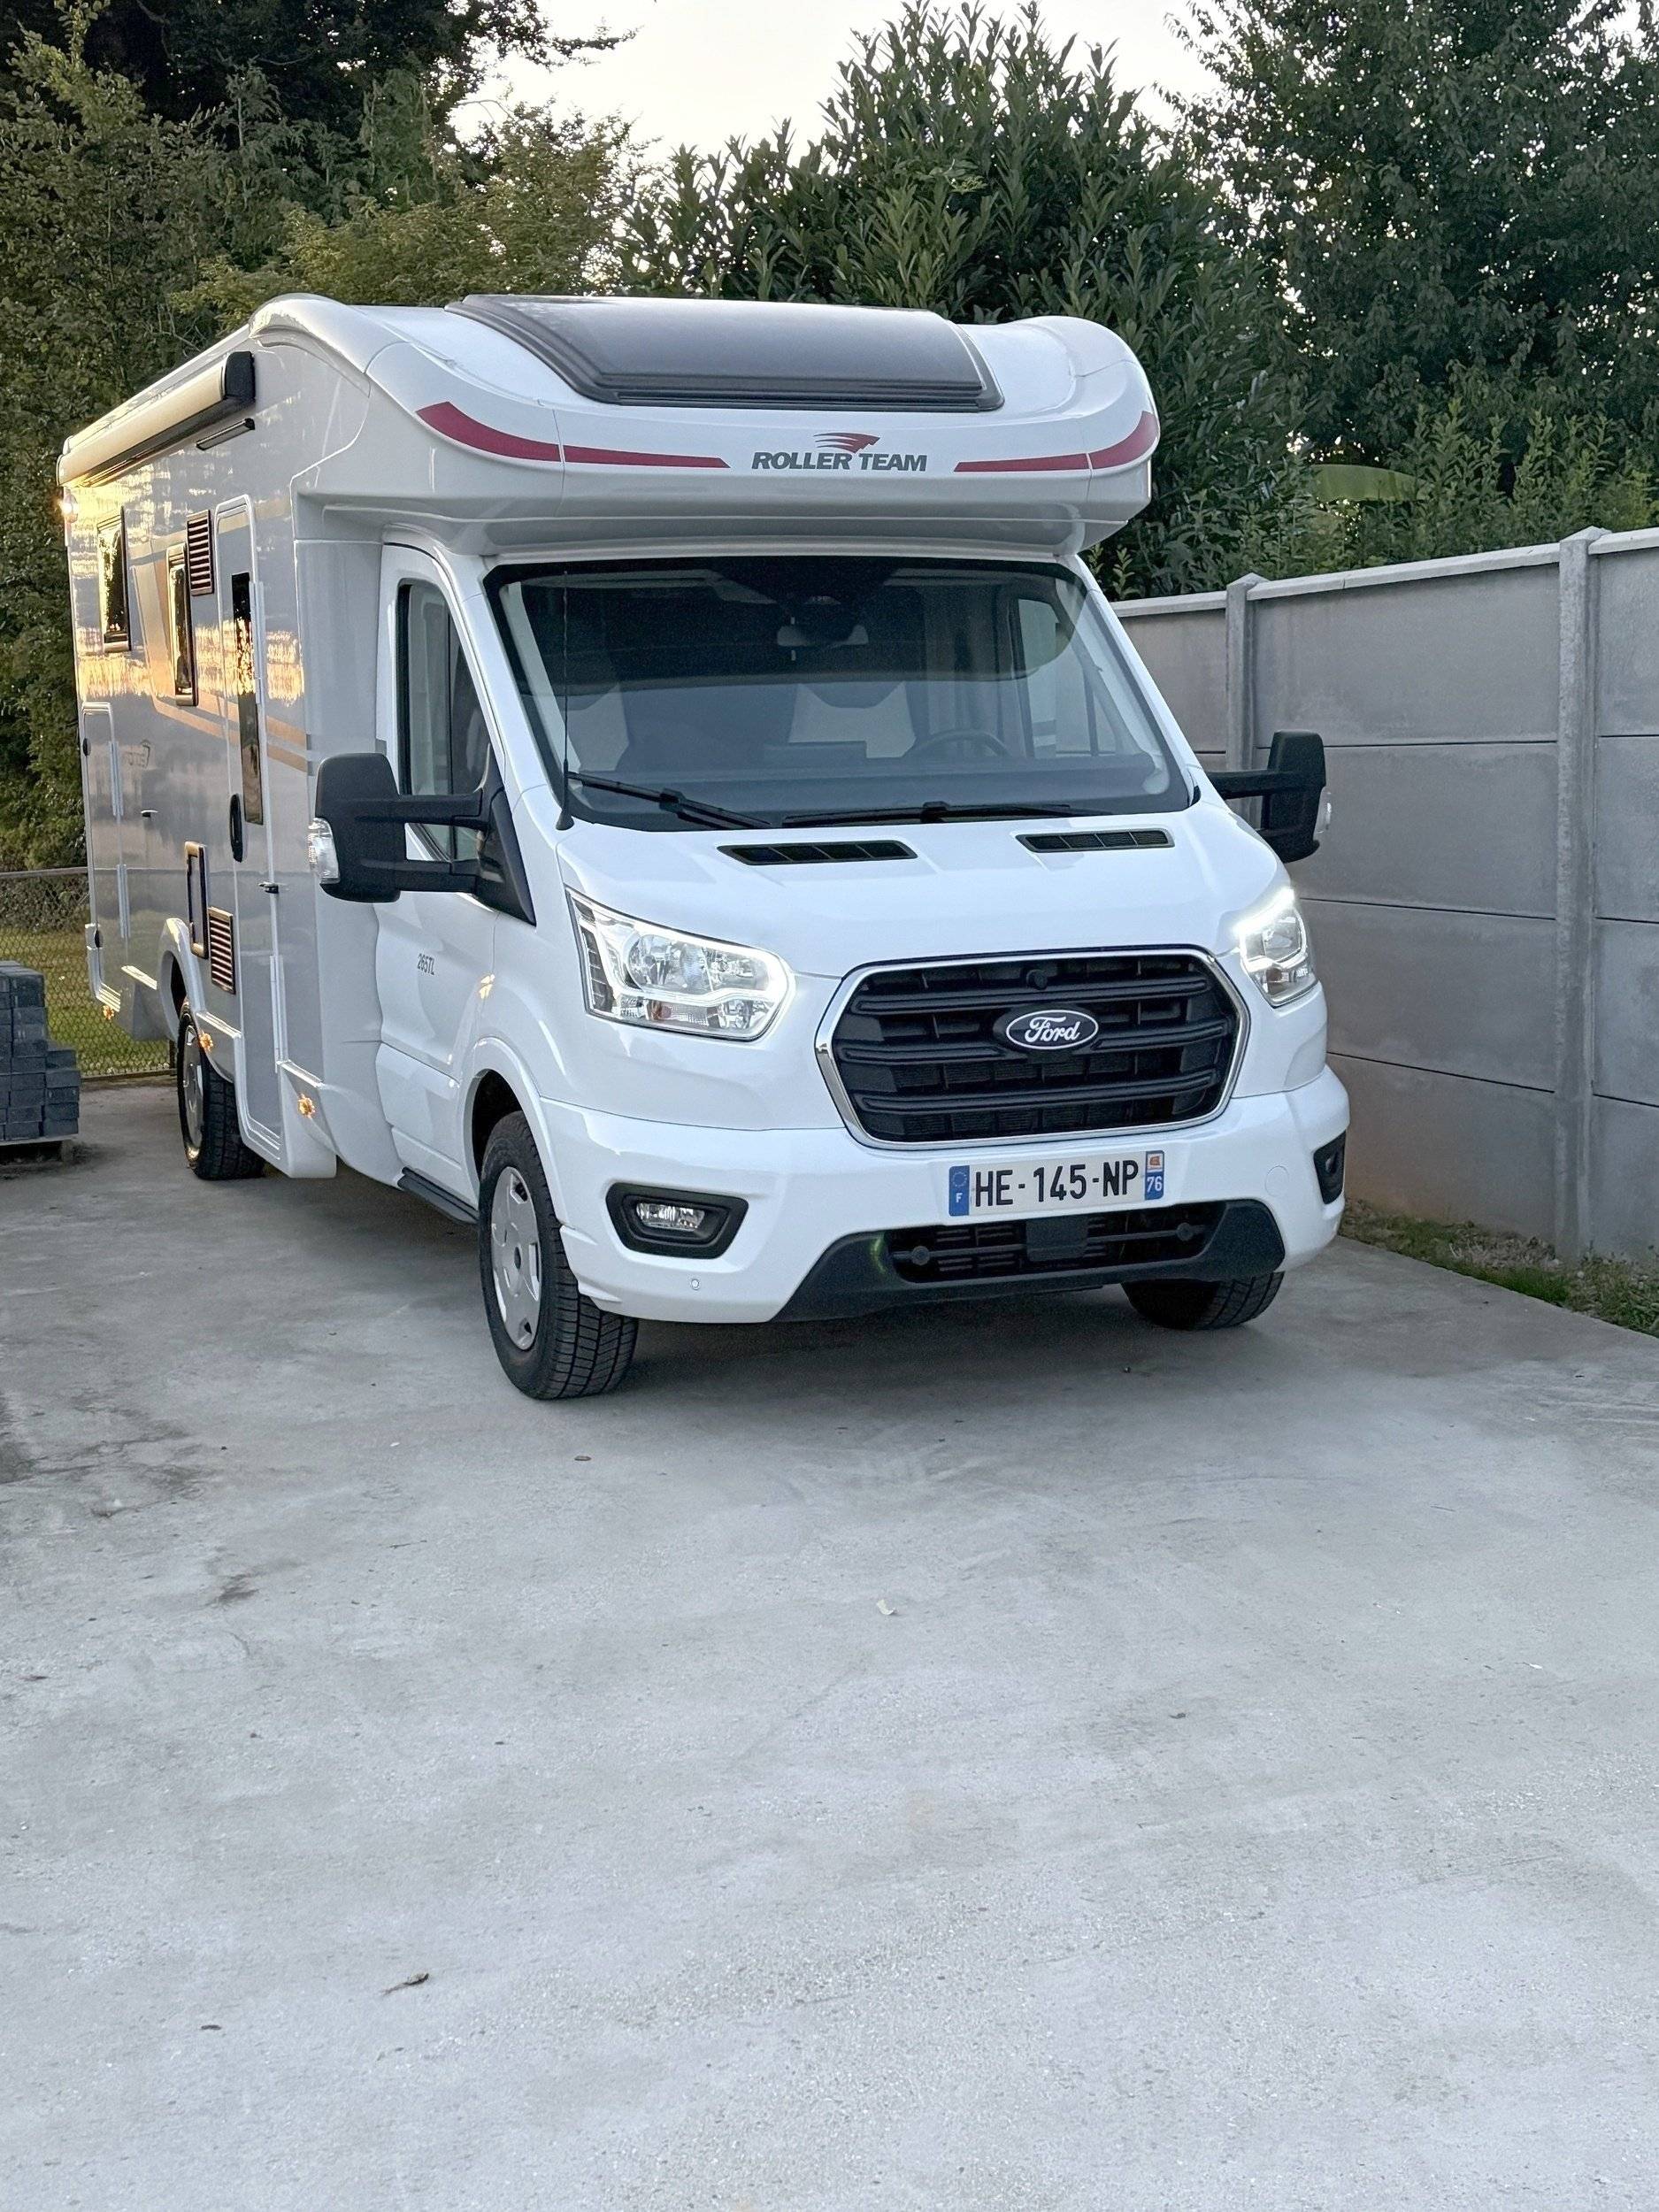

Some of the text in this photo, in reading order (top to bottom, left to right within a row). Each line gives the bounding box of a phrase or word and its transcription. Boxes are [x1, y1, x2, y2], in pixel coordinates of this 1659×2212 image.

[751, 451, 927, 472] ROLLER TEAM
[1025, 1016, 1080, 1042] Ford
[1147, 1176, 1163, 1193] 76
[956, 1192, 963, 1203] F
